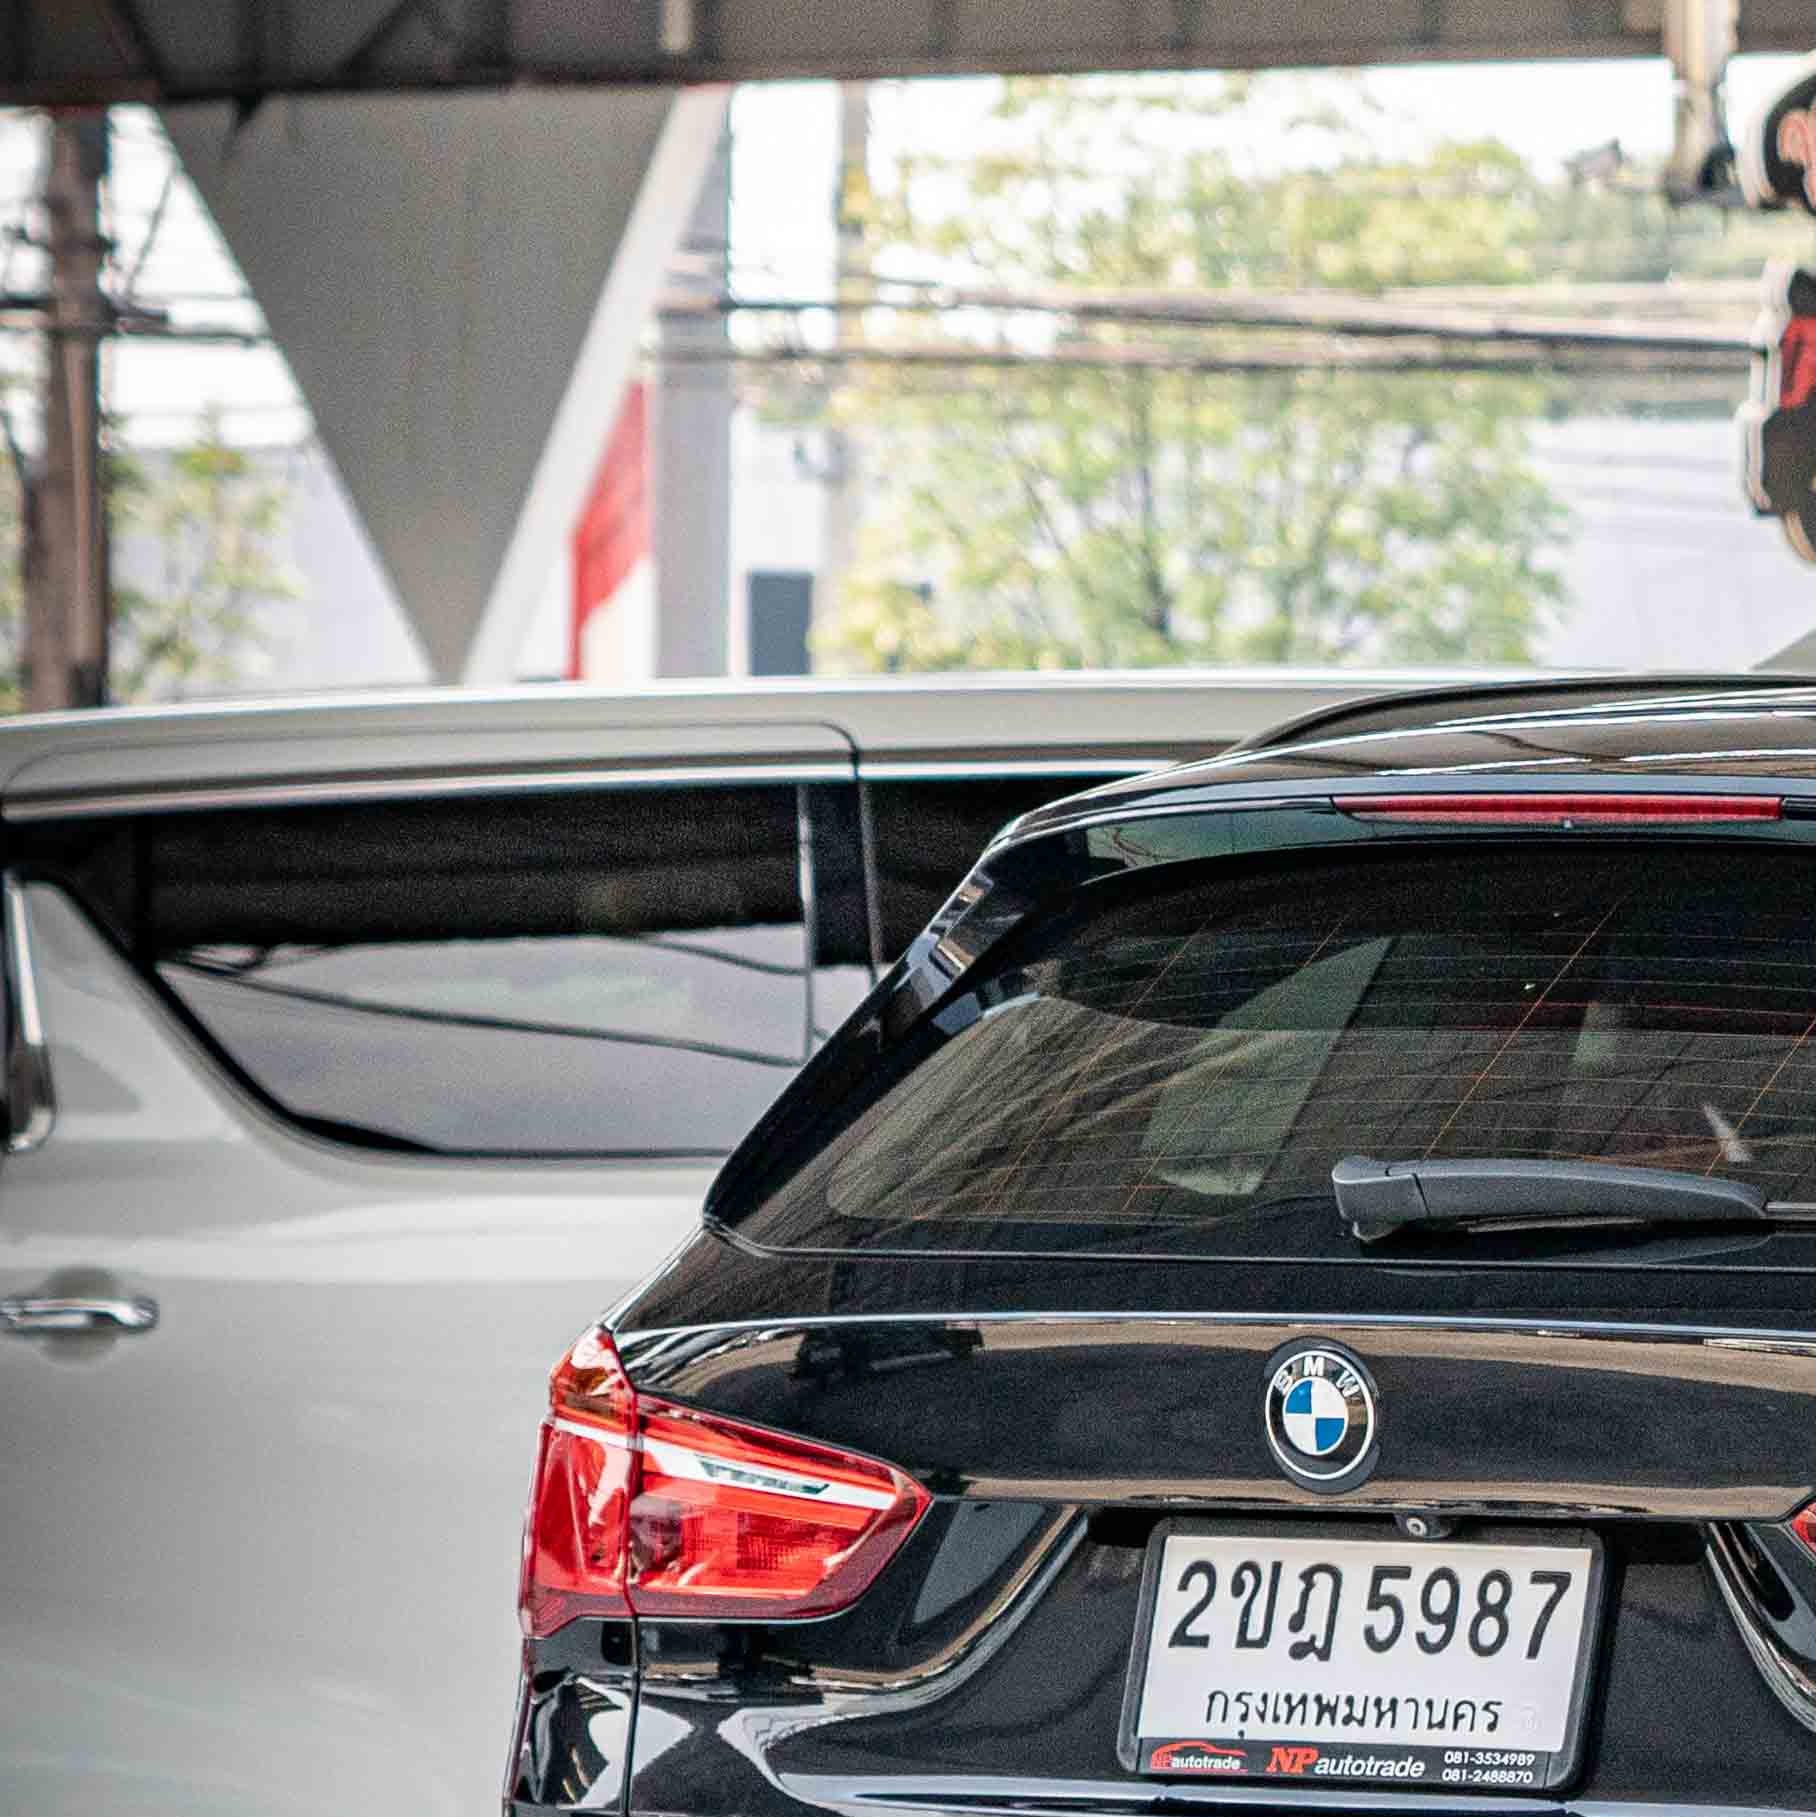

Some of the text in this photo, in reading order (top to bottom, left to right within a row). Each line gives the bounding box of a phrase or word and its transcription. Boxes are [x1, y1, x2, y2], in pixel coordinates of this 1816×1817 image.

[1274, 1355, 1360, 1399] BMW
[1362, 1564, 1572, 1660] 5987
[1204, 1688, 1503, 1738] กรุงเทพมหานคร
[1171, 1755, 1241, 1769] autotrade
[1265, 1746, 1426, 1778] NP autotrade
